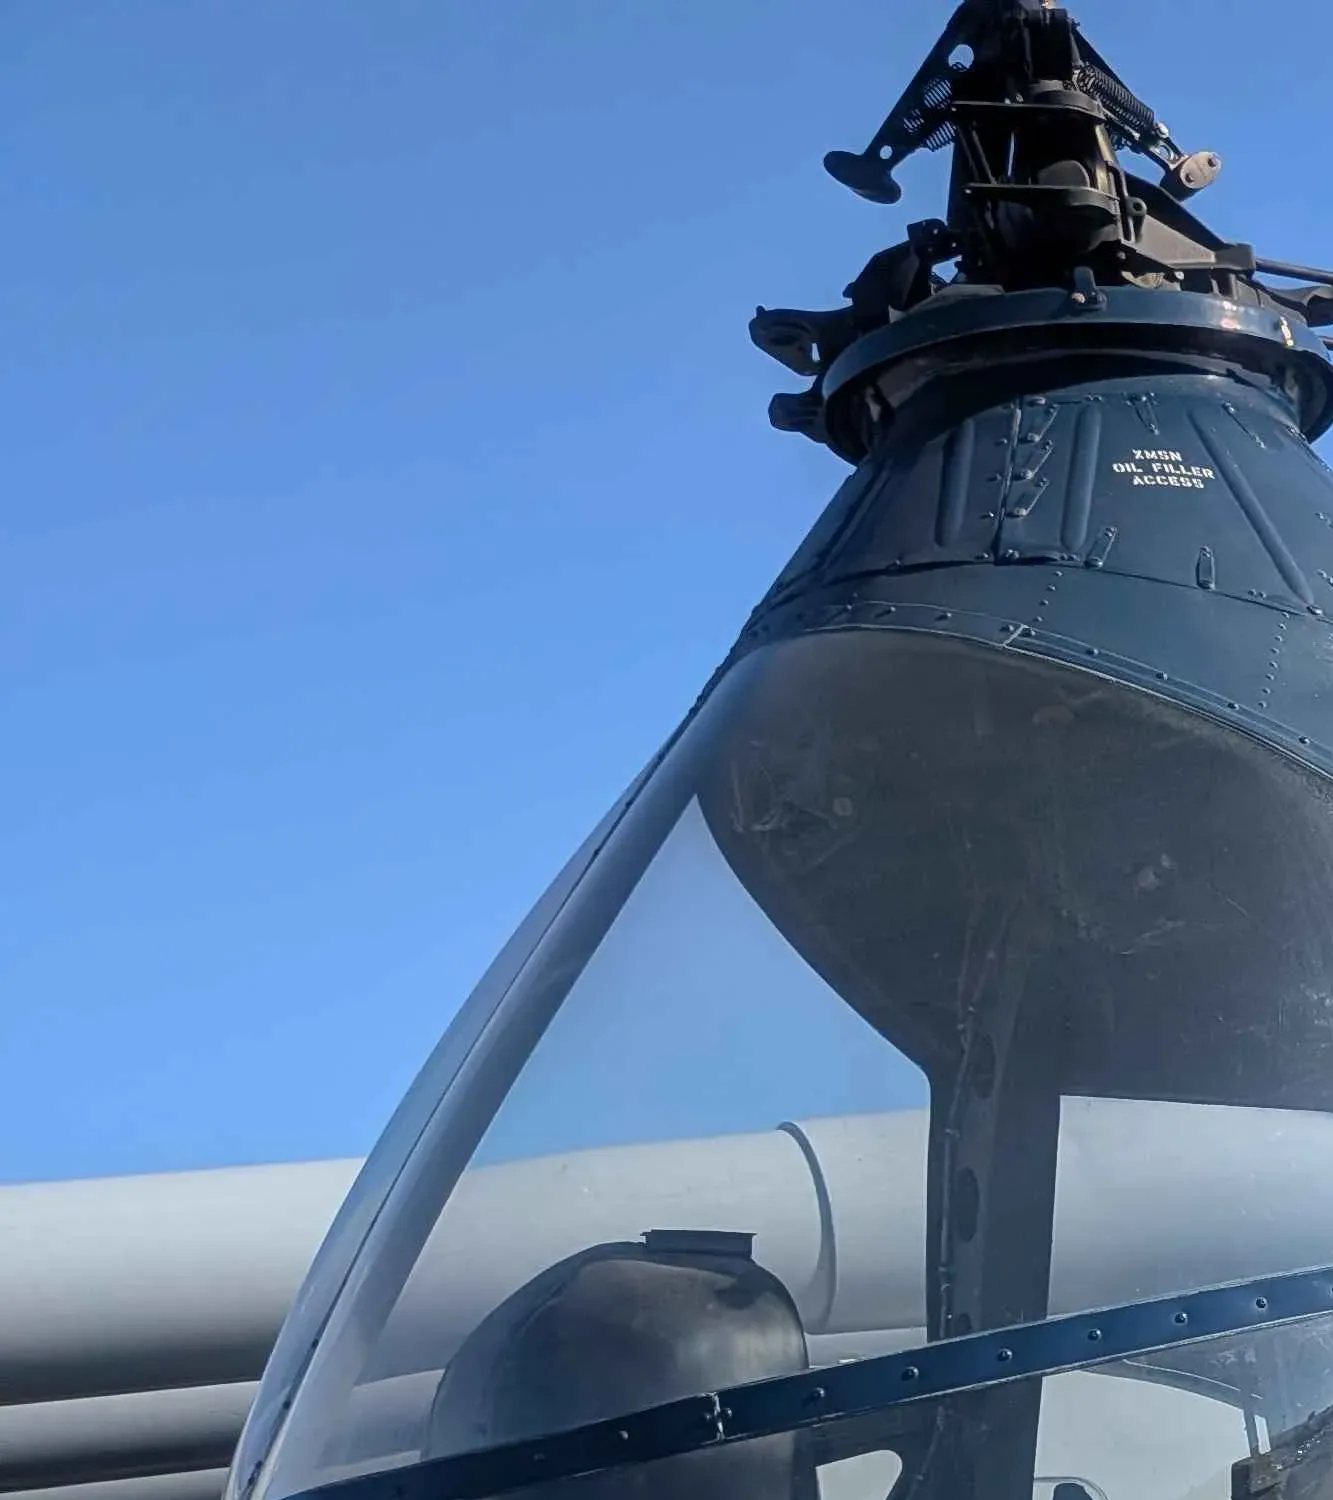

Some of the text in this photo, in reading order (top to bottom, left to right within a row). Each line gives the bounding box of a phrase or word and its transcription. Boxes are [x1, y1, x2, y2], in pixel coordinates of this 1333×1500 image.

[1132, 449, 1182, 461] XMSN
[1112, 462, 1216, 479] OIL FILLER
[1133, 475, 1204, 489] ACCESS
